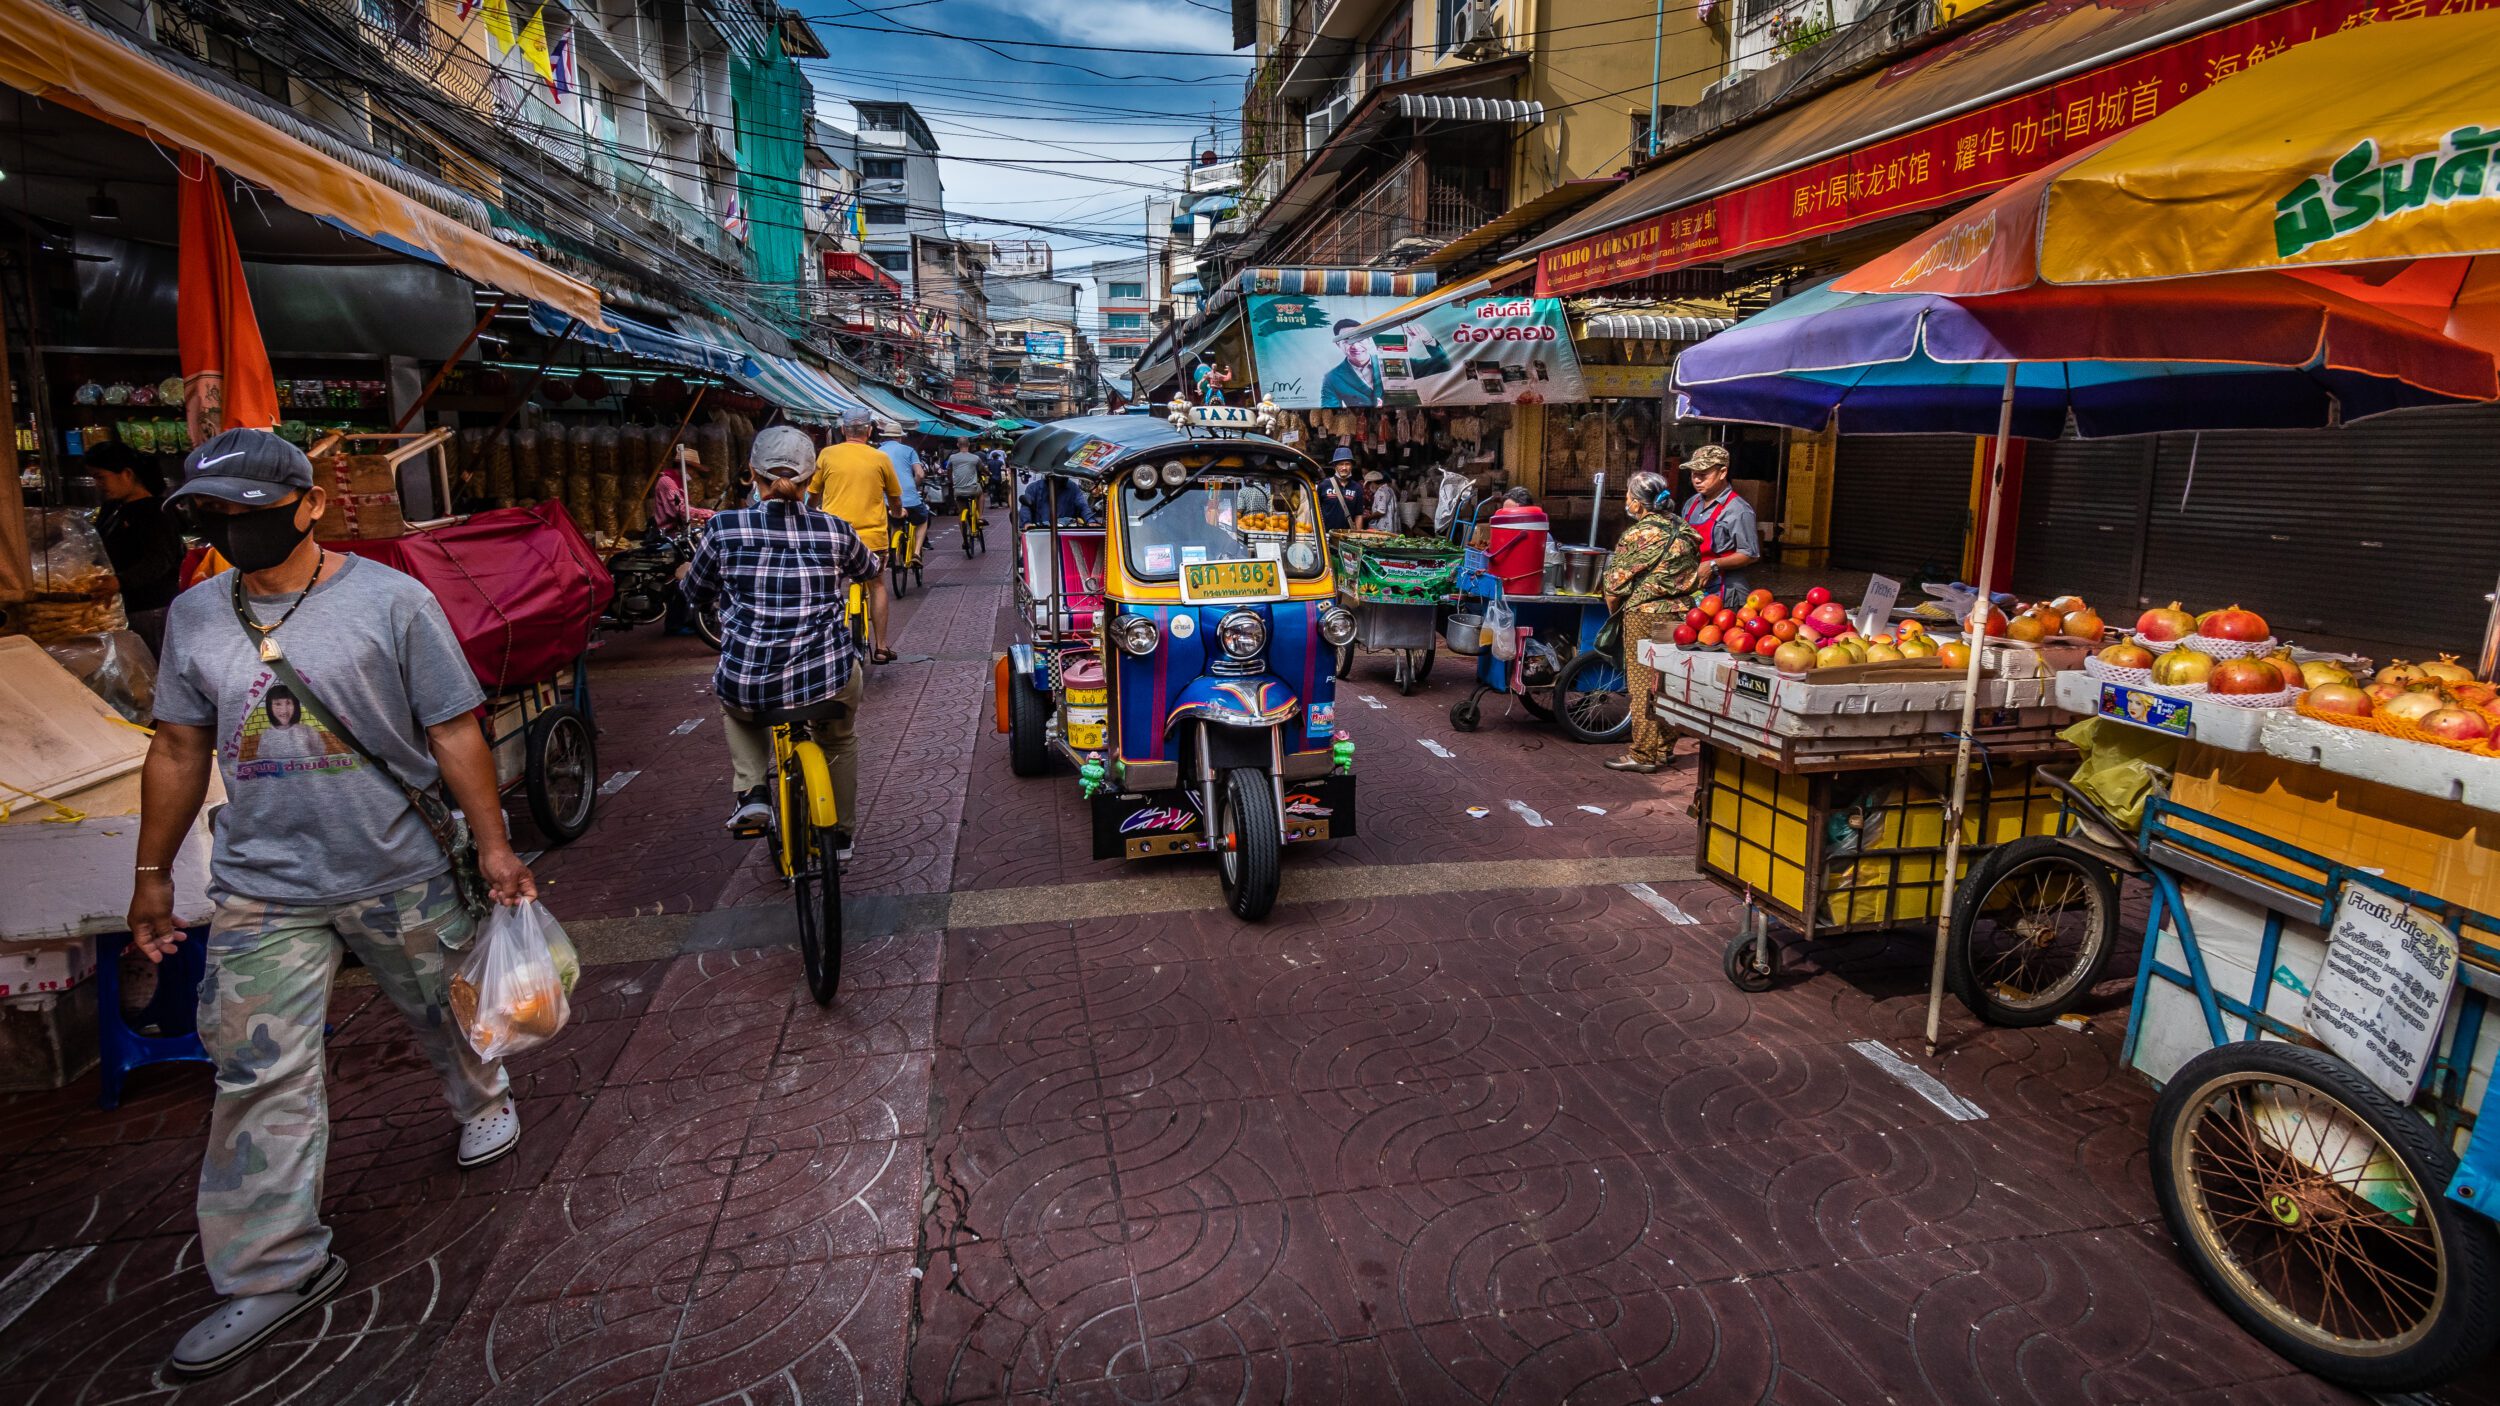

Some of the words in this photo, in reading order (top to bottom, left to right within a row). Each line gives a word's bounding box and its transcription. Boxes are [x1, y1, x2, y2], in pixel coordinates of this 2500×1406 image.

[1670, 208, 1718, 239] 珍宝龙虾
[1546, 246, 1591, 273] JUMBO
[1594, 225, 1660, 259] LOBSTER
[1616, 256, 1640, 270] Seafood
[1680, 236, 1719, 254] Chinatown
[1453, 323, 1556, 343] ต้องลอง
[1196, 408, 1248, 421] TAXI
[1228, 562, 1275, 585] 1961
[2153, 697, 2176, 709] Pretty
[2157, 705, 2174, 716] Lady
[2348, 890, 2392, 923] Fruit
[2390, 913, 2428, 946] juice
[2332, 934, 2384, 968] Pomegranate
[2314, 990, 2341, 1013] Orange
